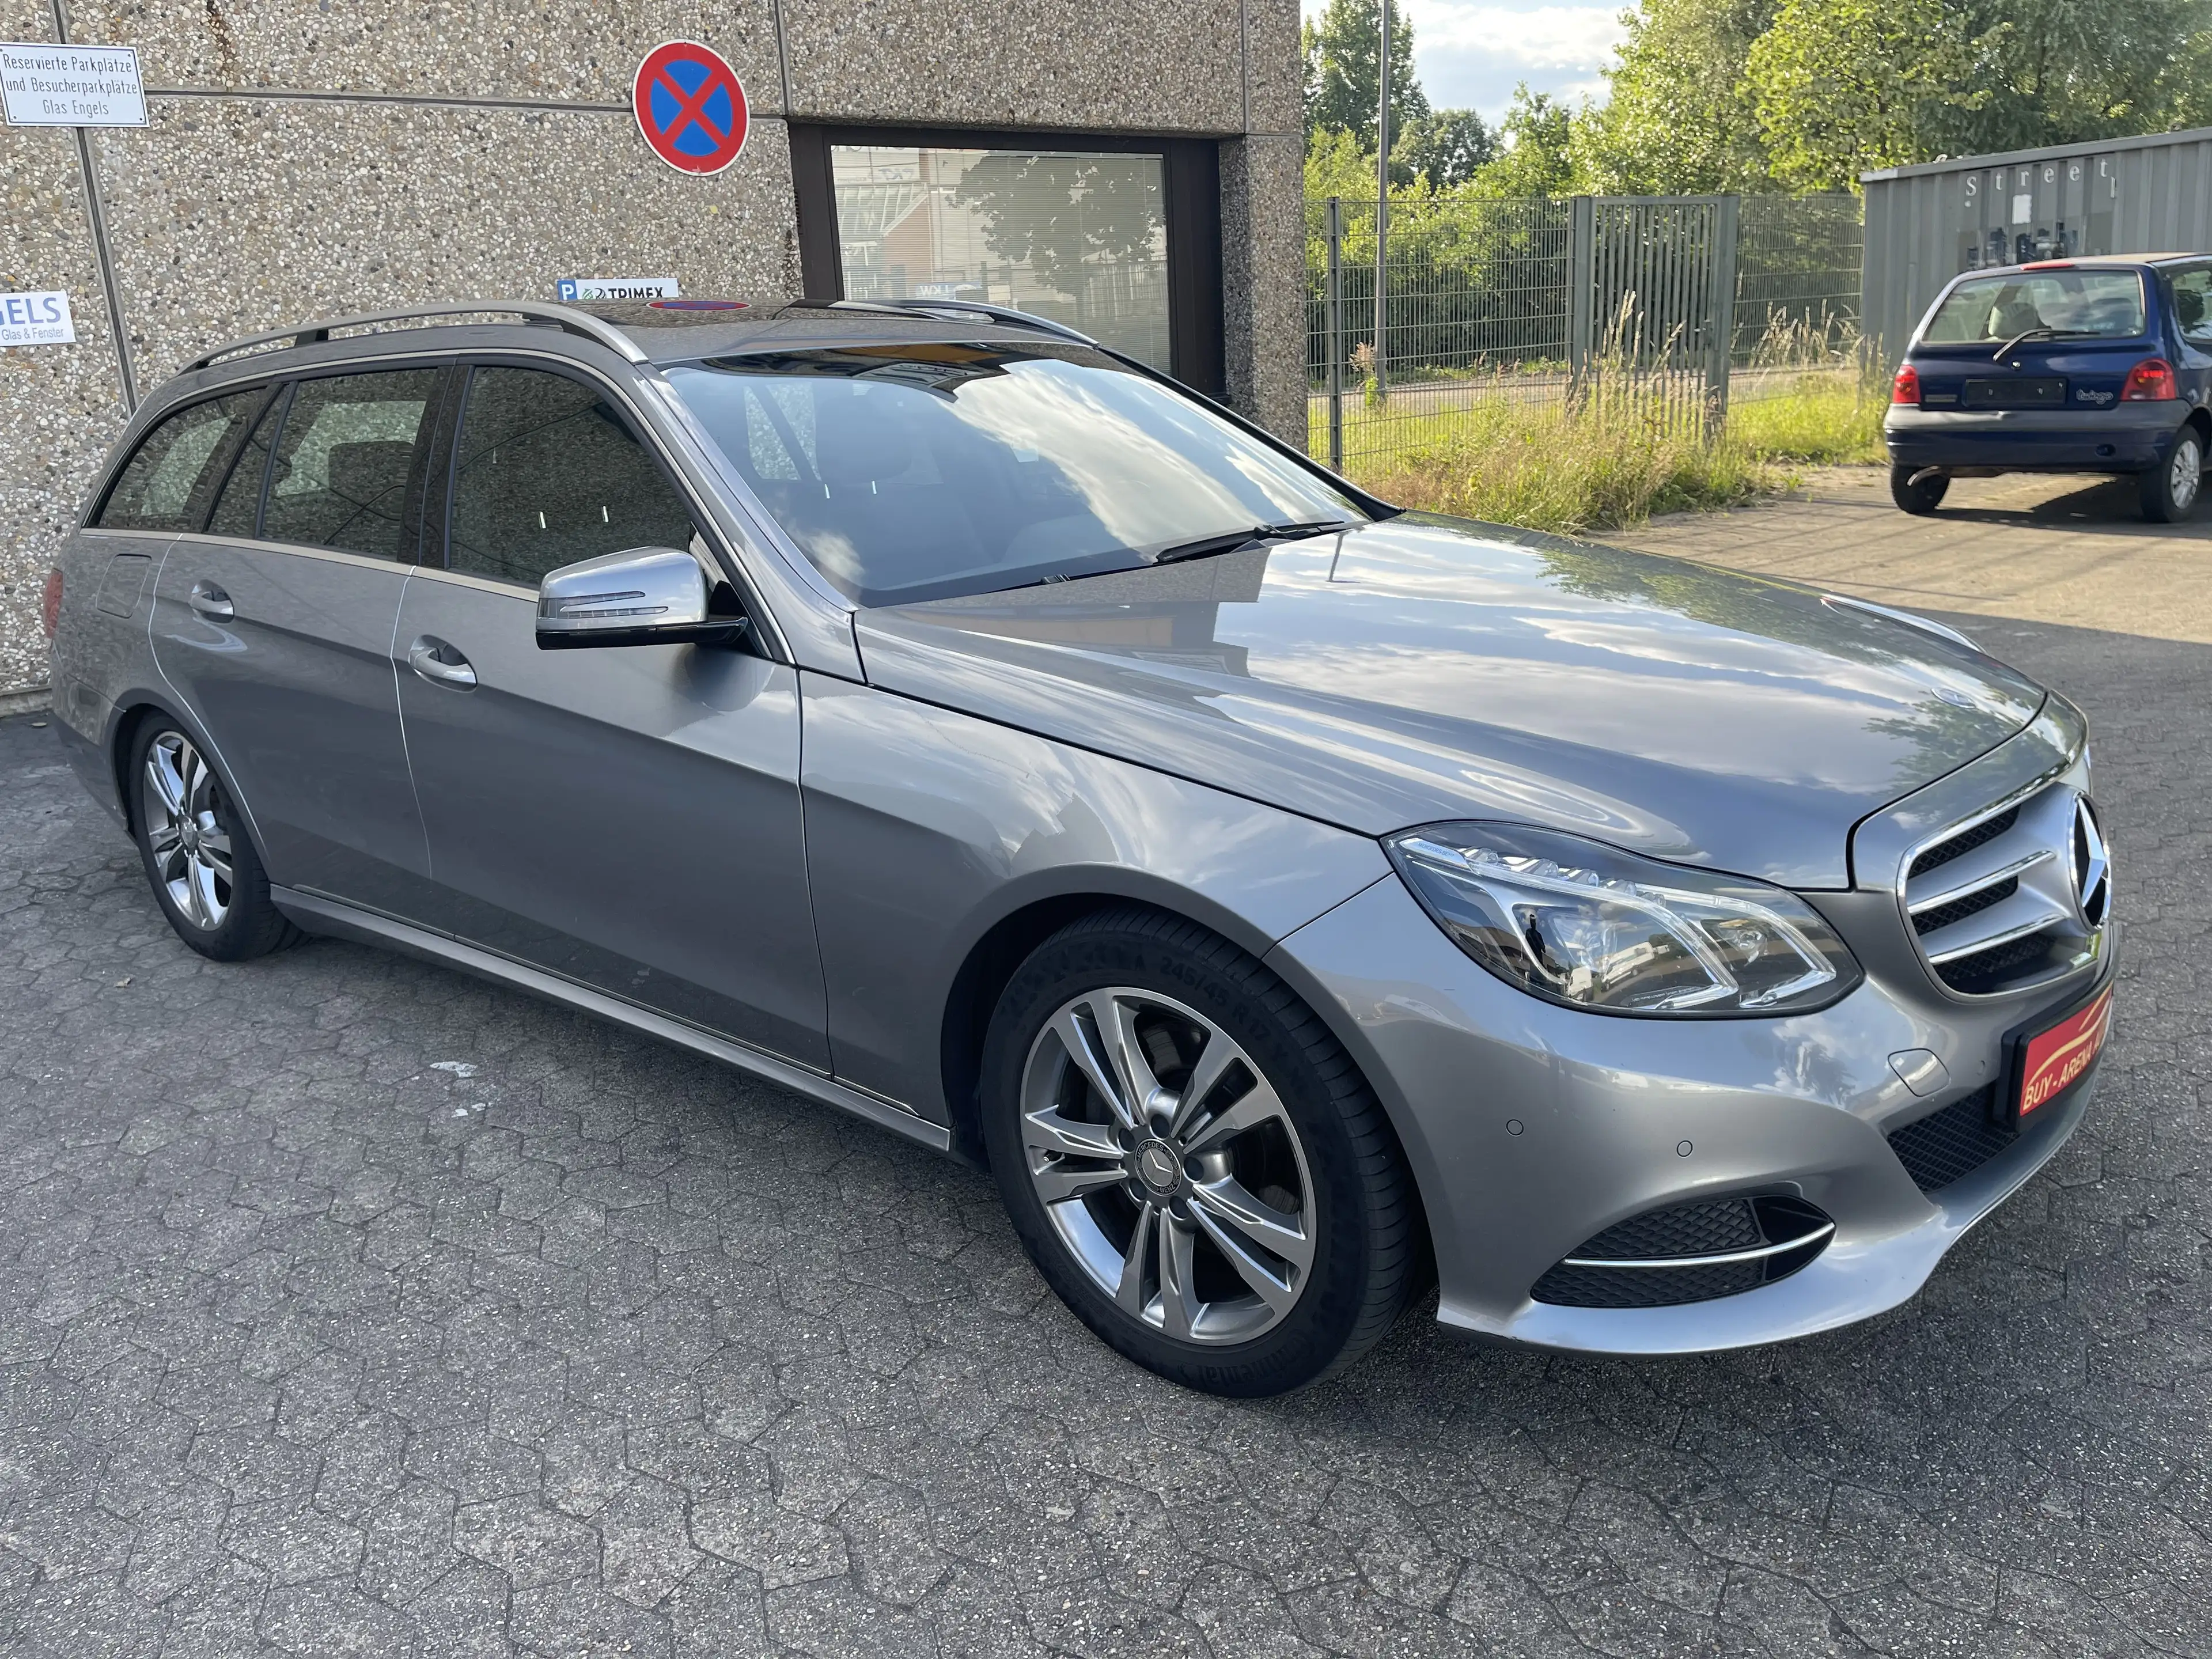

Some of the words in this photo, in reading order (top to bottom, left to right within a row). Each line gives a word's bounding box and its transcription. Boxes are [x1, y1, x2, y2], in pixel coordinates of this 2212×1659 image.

[3, 54, 67, 70] Reservierte
[71, 56, 132, 75] Parkplätze
[6, 77, 26, 92] und
[31, 77, 138, 97] Besucherparkplätze
[43, 100, 67, 115] Glas
[72, 100, 109, 119] Engels
[2, 328, 22, 340] Glas
[24, 328, 31, 340] &
[32, 327, 65, 339] Fenster
[1137, 1142, 1164, 1159] MERCEDES
[1159, 1183, 1176, 1194] BENZ
